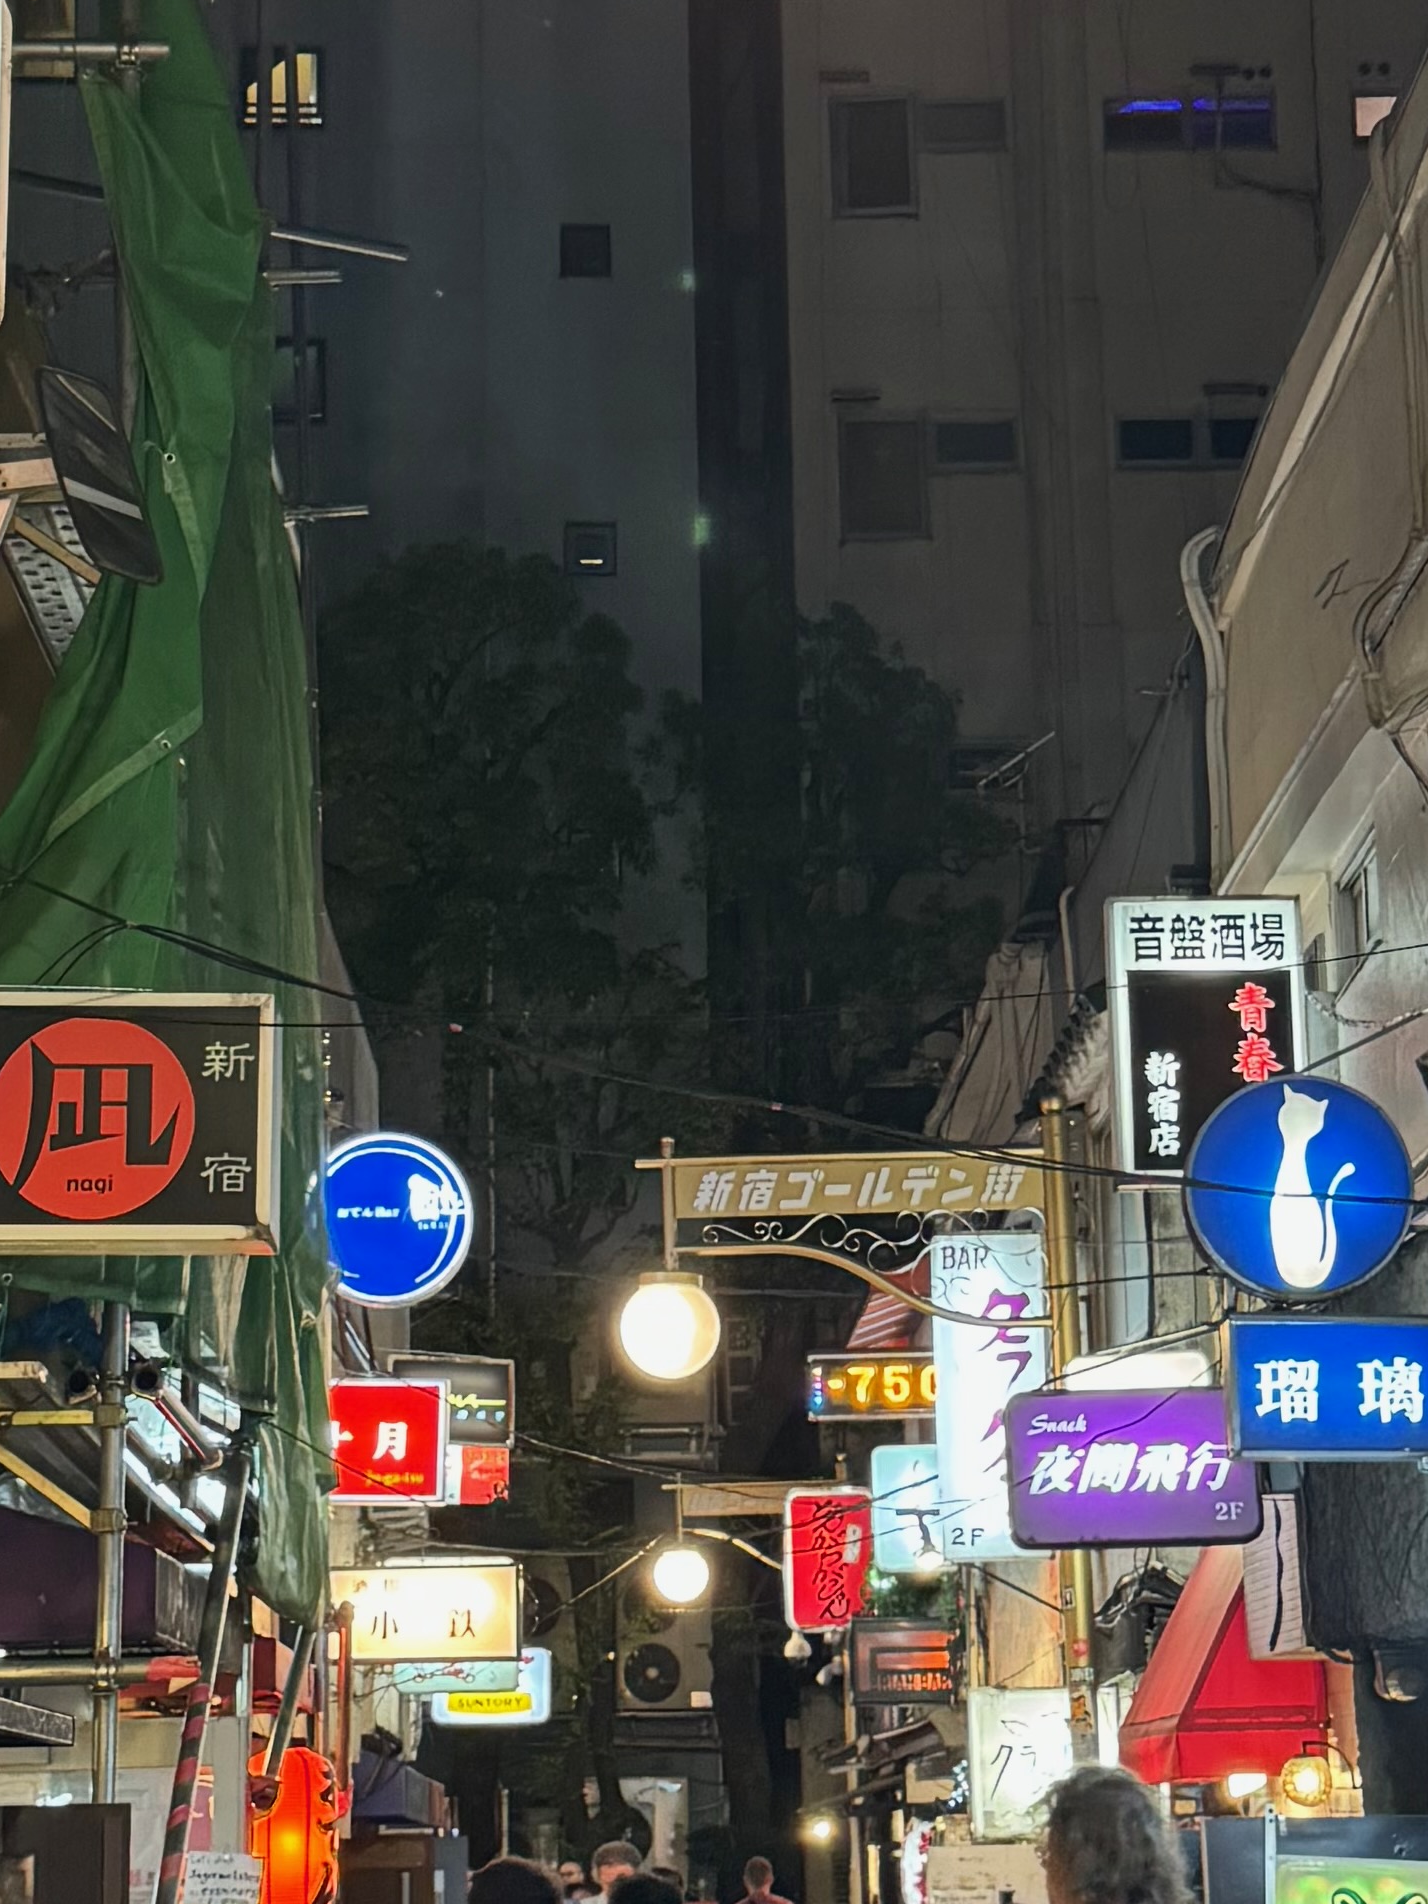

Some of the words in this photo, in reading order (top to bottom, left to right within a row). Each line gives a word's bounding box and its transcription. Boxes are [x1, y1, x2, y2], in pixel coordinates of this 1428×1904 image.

[1128, 912, 1285, 962] 音盤酒場
[1228, 981, 1284, 1083] 青春
[11, 1038, 182, 1188] 凪
[201, 1040, 255, 1194] 新宿
[1144, 1051, 1180, 1158] 新宿店
[66, 1173, 113, 1195] nagi
[693, 1164, 1023, 1211] 新宿ゴールデン街
[941, 1245, 989, 1270] BAR
[1254, 1357, 1425, 1424] 瑠璃
[1027, 1413, 1087, 1435] Snack
[1027, 1441, 1234, 1496] 夜間飛行
[1215, 1501, 1244, 1521] 2F
[951, 1526, 984, 1547] 2F
[457, 1697, 524, 1708] SUNTORY
